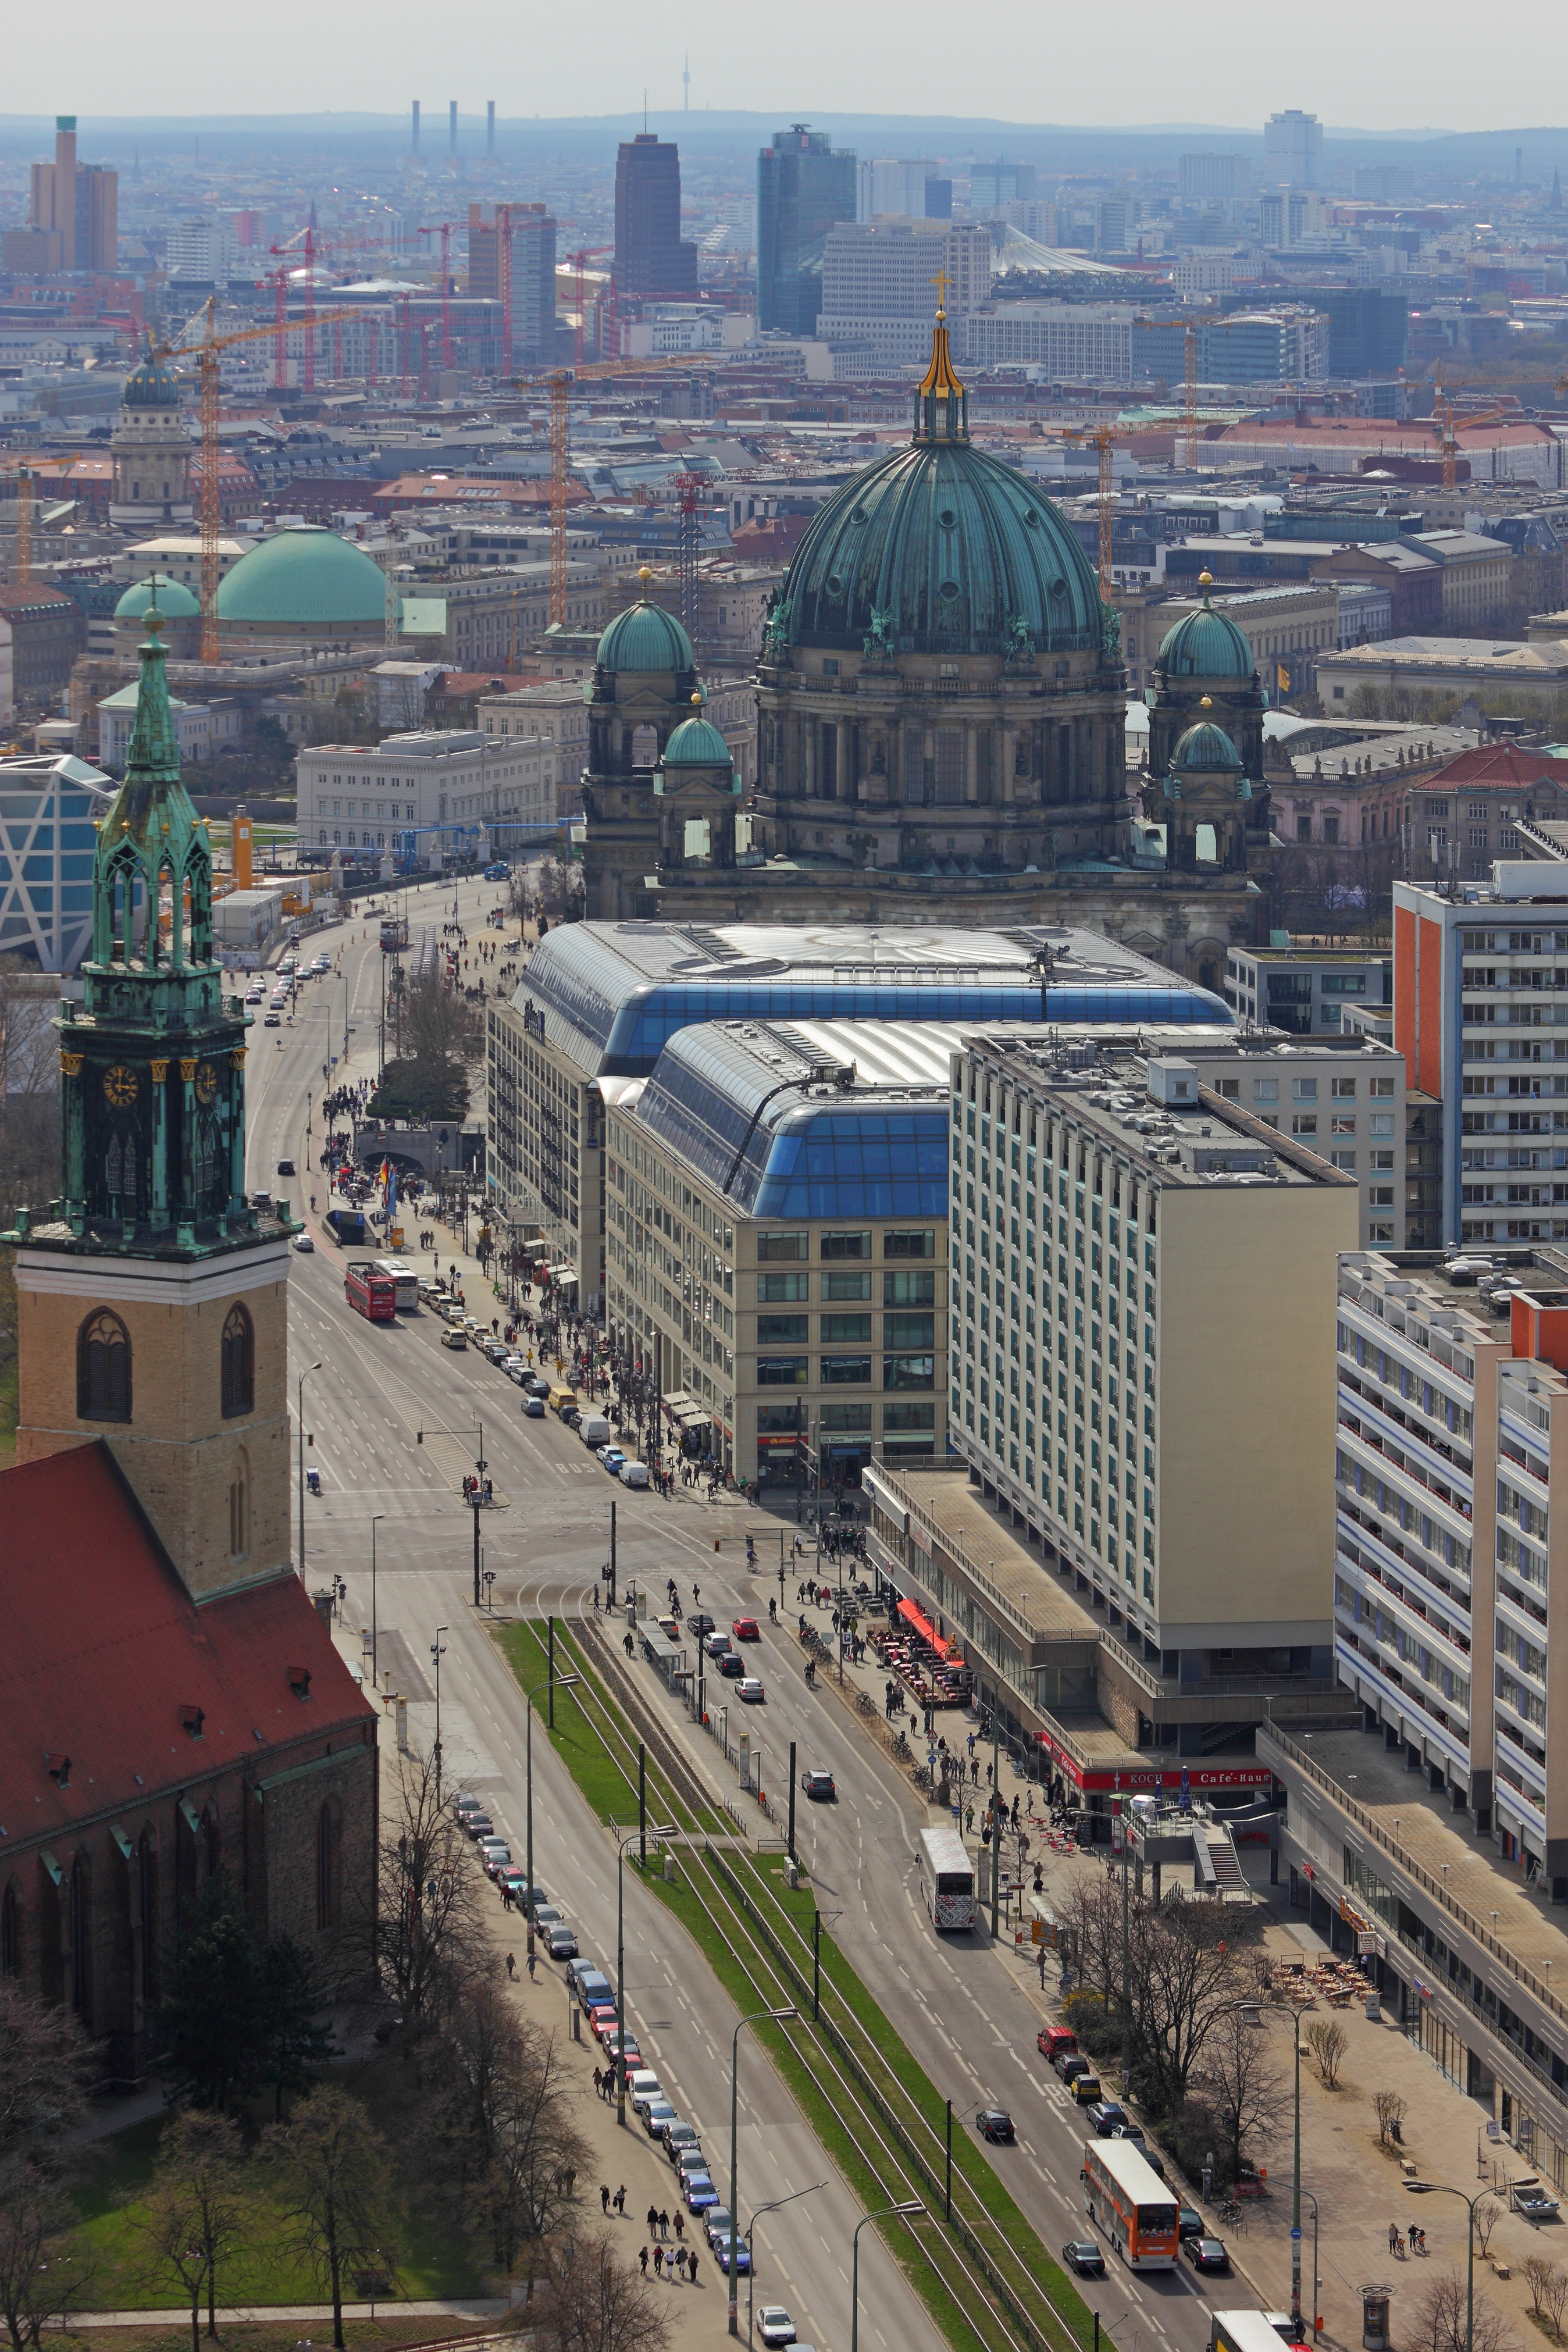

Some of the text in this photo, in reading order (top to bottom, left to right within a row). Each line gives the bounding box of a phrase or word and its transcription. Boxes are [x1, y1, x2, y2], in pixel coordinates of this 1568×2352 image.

[555, 1463, 596, 1473] BUS
[1130, 1773, 1268, 1784] KOCH Café-Haus
